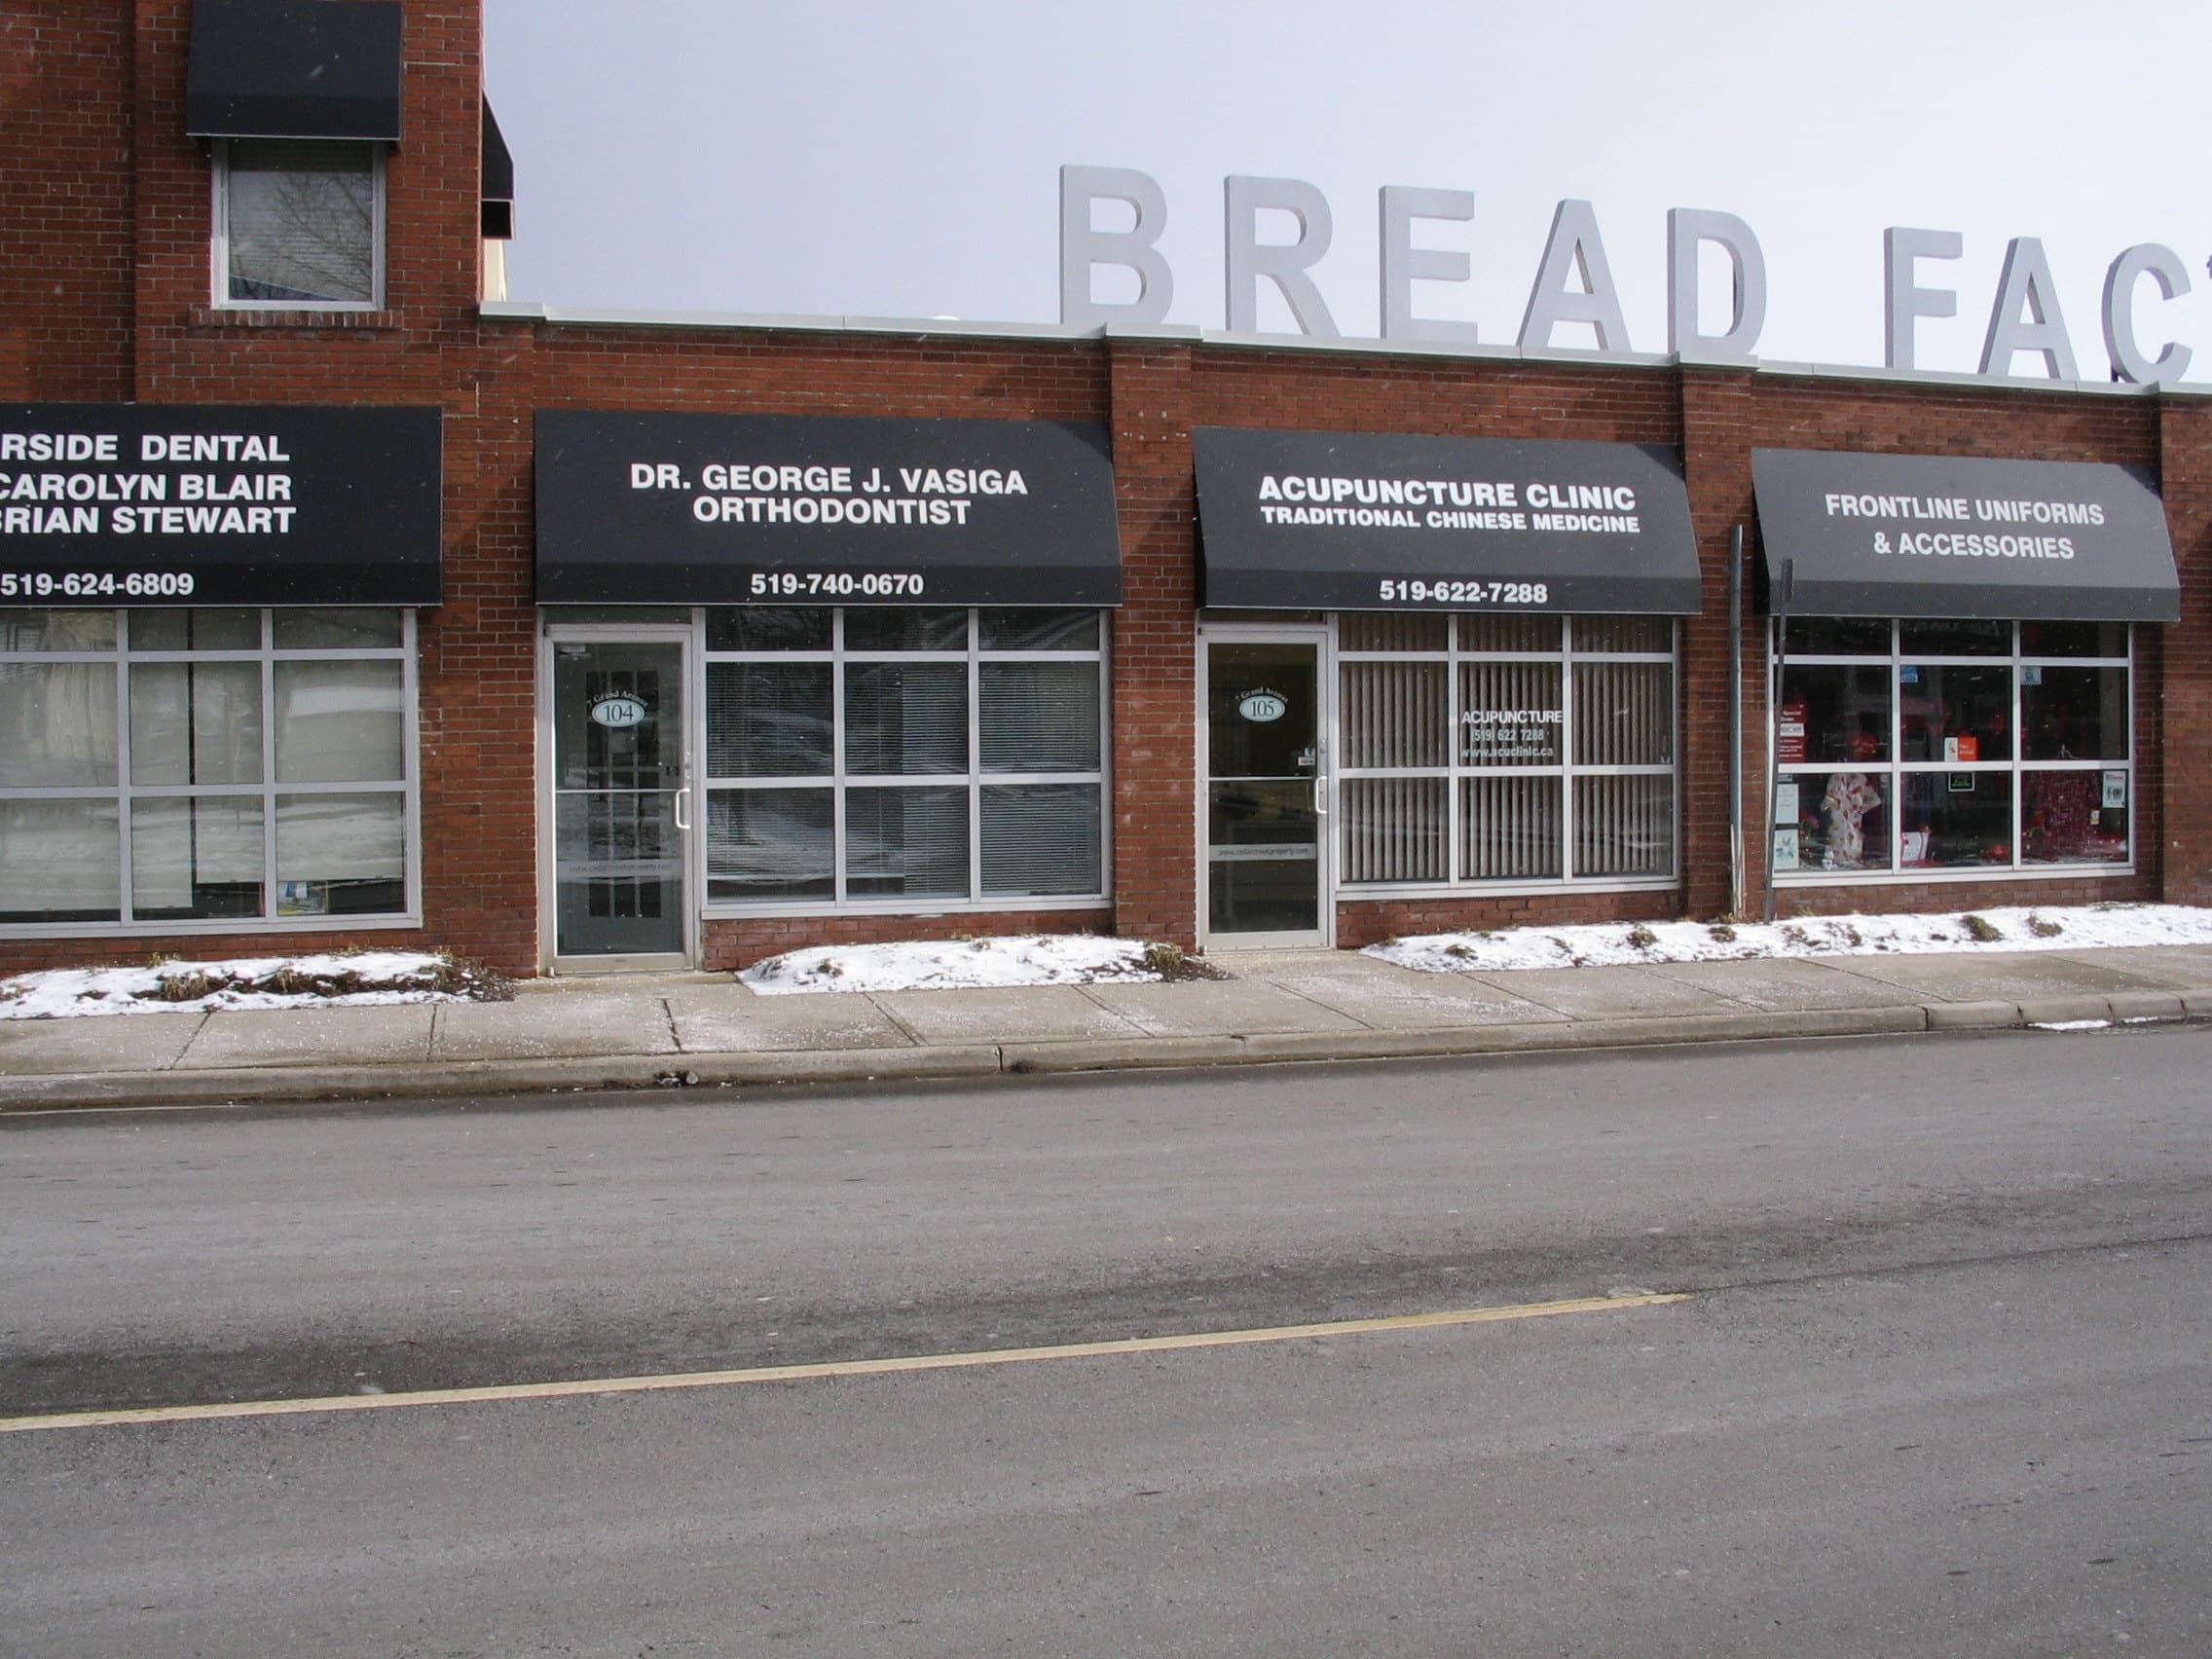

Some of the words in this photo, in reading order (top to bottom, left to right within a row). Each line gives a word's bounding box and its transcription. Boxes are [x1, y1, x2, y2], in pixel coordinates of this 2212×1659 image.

[1059, 164, 1767, 356] BREAD
[1884, 225, 2212, 384] FAC
[1, 433, 118, 461] RSIDE
[141, 434, 290, 461] DENTAL
[179, 474, 291, 500] BLAIR
[631, 462, 691, 490] DR.
[702, 464, 853, 493] GEORGE
[862, 467, 891, 494] J.
[899, 468, 1028, 495] VASIGA
[1258, 475, 1518, 507] ACUPUNCTURE
[1526, 483, 1637, 511] CLINIC
[0, 506, 99, 534] RIAN
[112, 506, 297, 535] STEWART
[693, 496, 972, 525] ORTHODONTIST
[1260, 505, 1420, 528] TRADITIONAL
[1425, 510, 1528, 531] CHINESE
[1531, 513, 1641, 534] MEDICINE
[1825, 494, 1971, 520] FRONTLINE
[1974, 498, 2105, 526] UNIFORMS
[1873, 531, 1892, 554] &
[1898, 532, 2075, 560] ACCESSORIES
[1, 572, 194, 596] 519-624-6809
[750, 572, 924, 596] 519-740-0670
[1380, 579, 1548, 604] 519-622-7288
[603, 704, 633, 721] 104
[1251, 700, 1274, 717] 105
[1461, 710, 1563, 723] ACUPUNCTURE
[1497, 728, 1517, 741] 622
[1521, 728, 1544, 741] 7288
